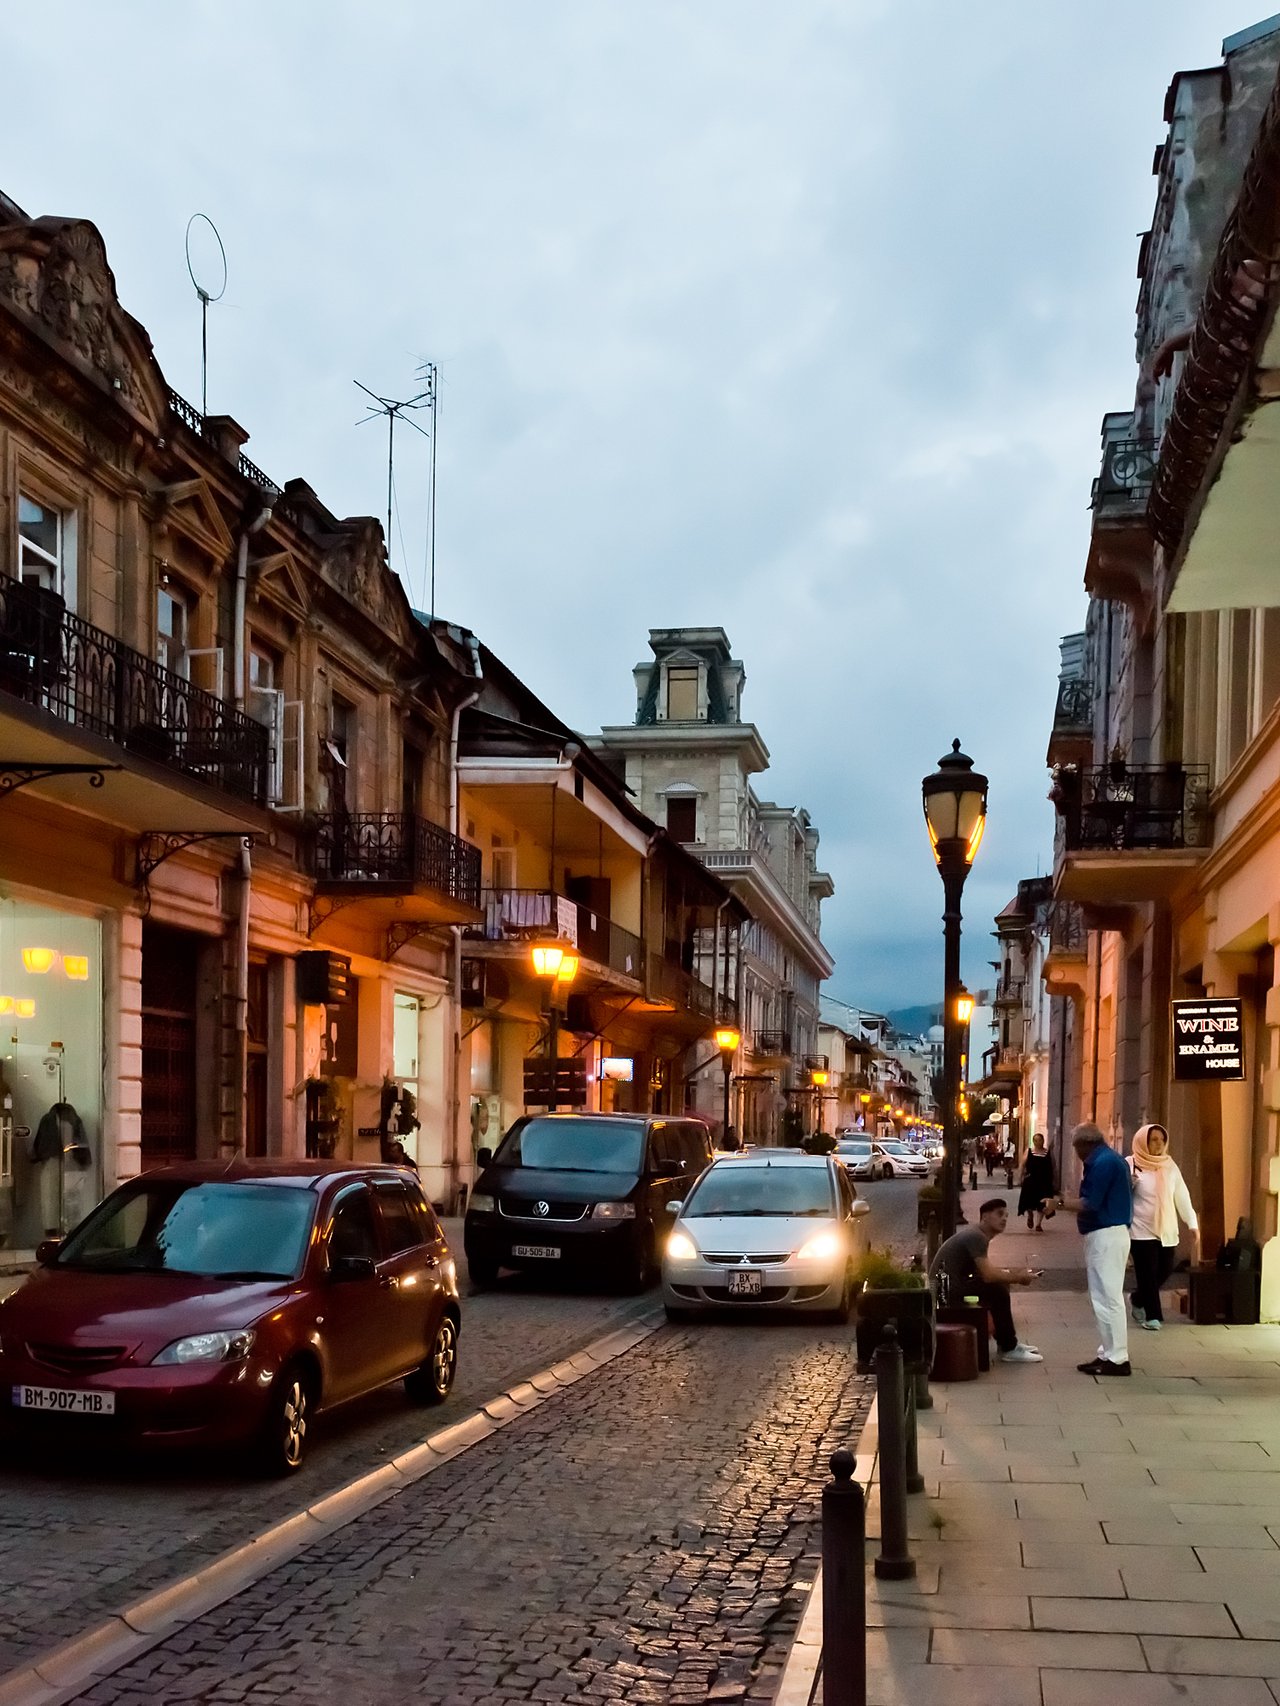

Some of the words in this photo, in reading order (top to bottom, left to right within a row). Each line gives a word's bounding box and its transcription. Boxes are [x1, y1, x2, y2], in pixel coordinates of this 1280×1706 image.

[1177, 1018, 1239, 1033] WINE
[1203, 1035, 1214, 1044] &
[1179, 1044, 1239, 1055] ENAMEL
[1206, 1058, 1240, 1068] HOUSE
[730, 1283, 760, 1293] 215-XB
[25, 1388, 102, 1411] BM-907-MB
